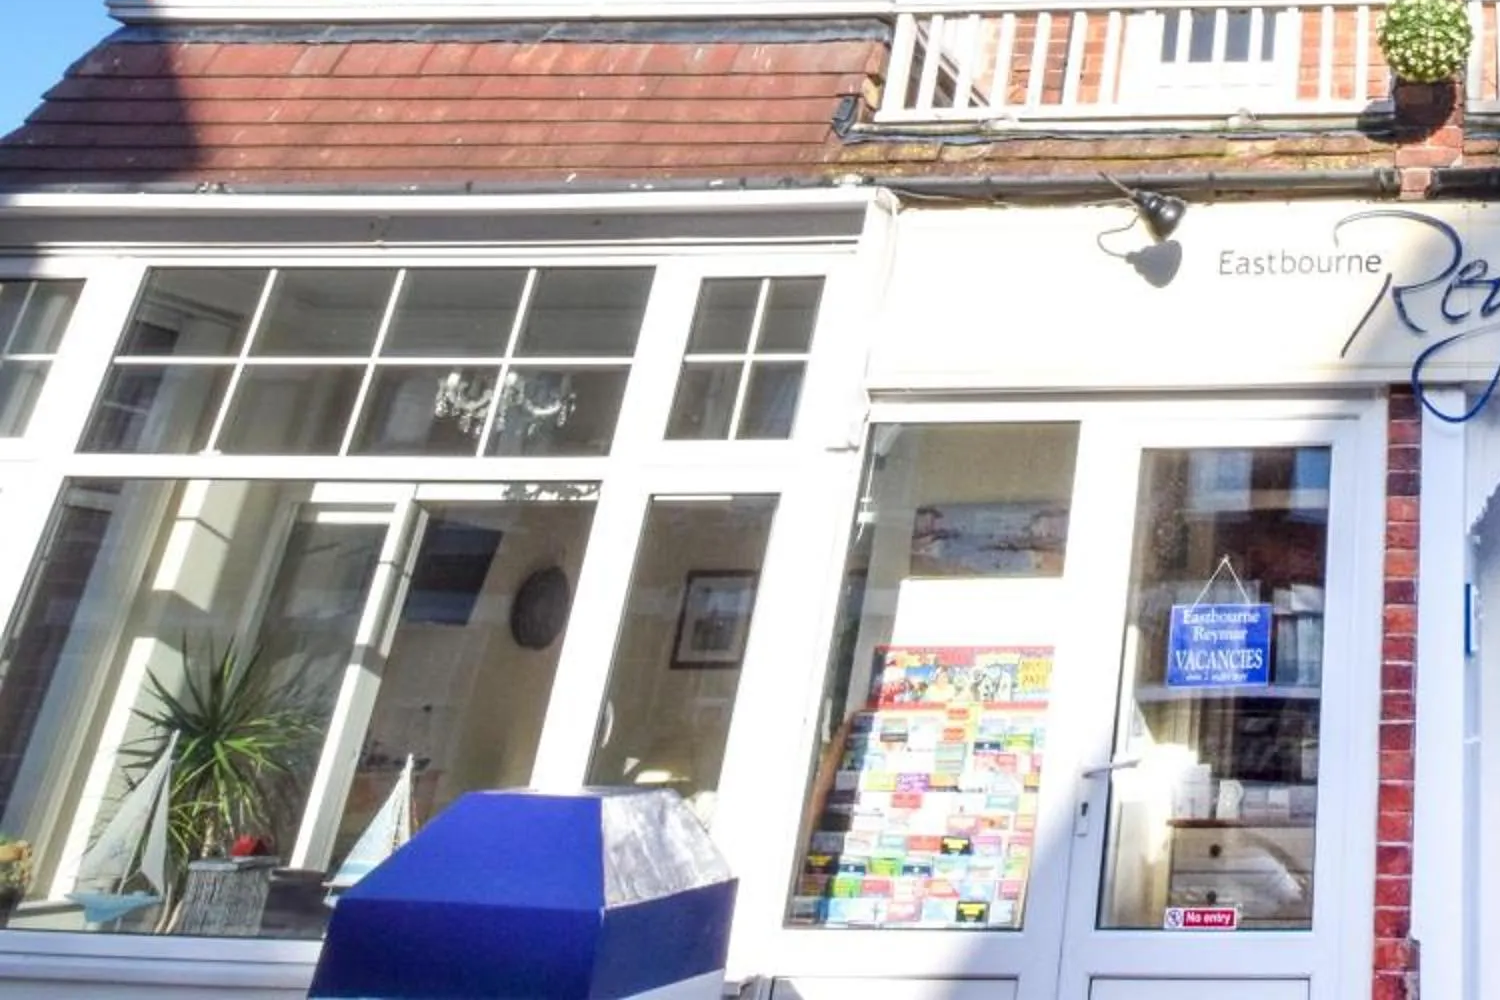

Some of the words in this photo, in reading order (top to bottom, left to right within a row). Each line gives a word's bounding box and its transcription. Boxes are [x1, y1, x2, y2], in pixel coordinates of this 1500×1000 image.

[1218, 250, 1382, 276] Eastbourne
[1184, 608, 1260, 624] Eastbourne
[1193, 626, 1249, 645] Reymar
[1175, 648, 1263, 671] VACANCIES
[1186, 912, 1202, 923] No
[1204, 912, 1231, 925] entry
